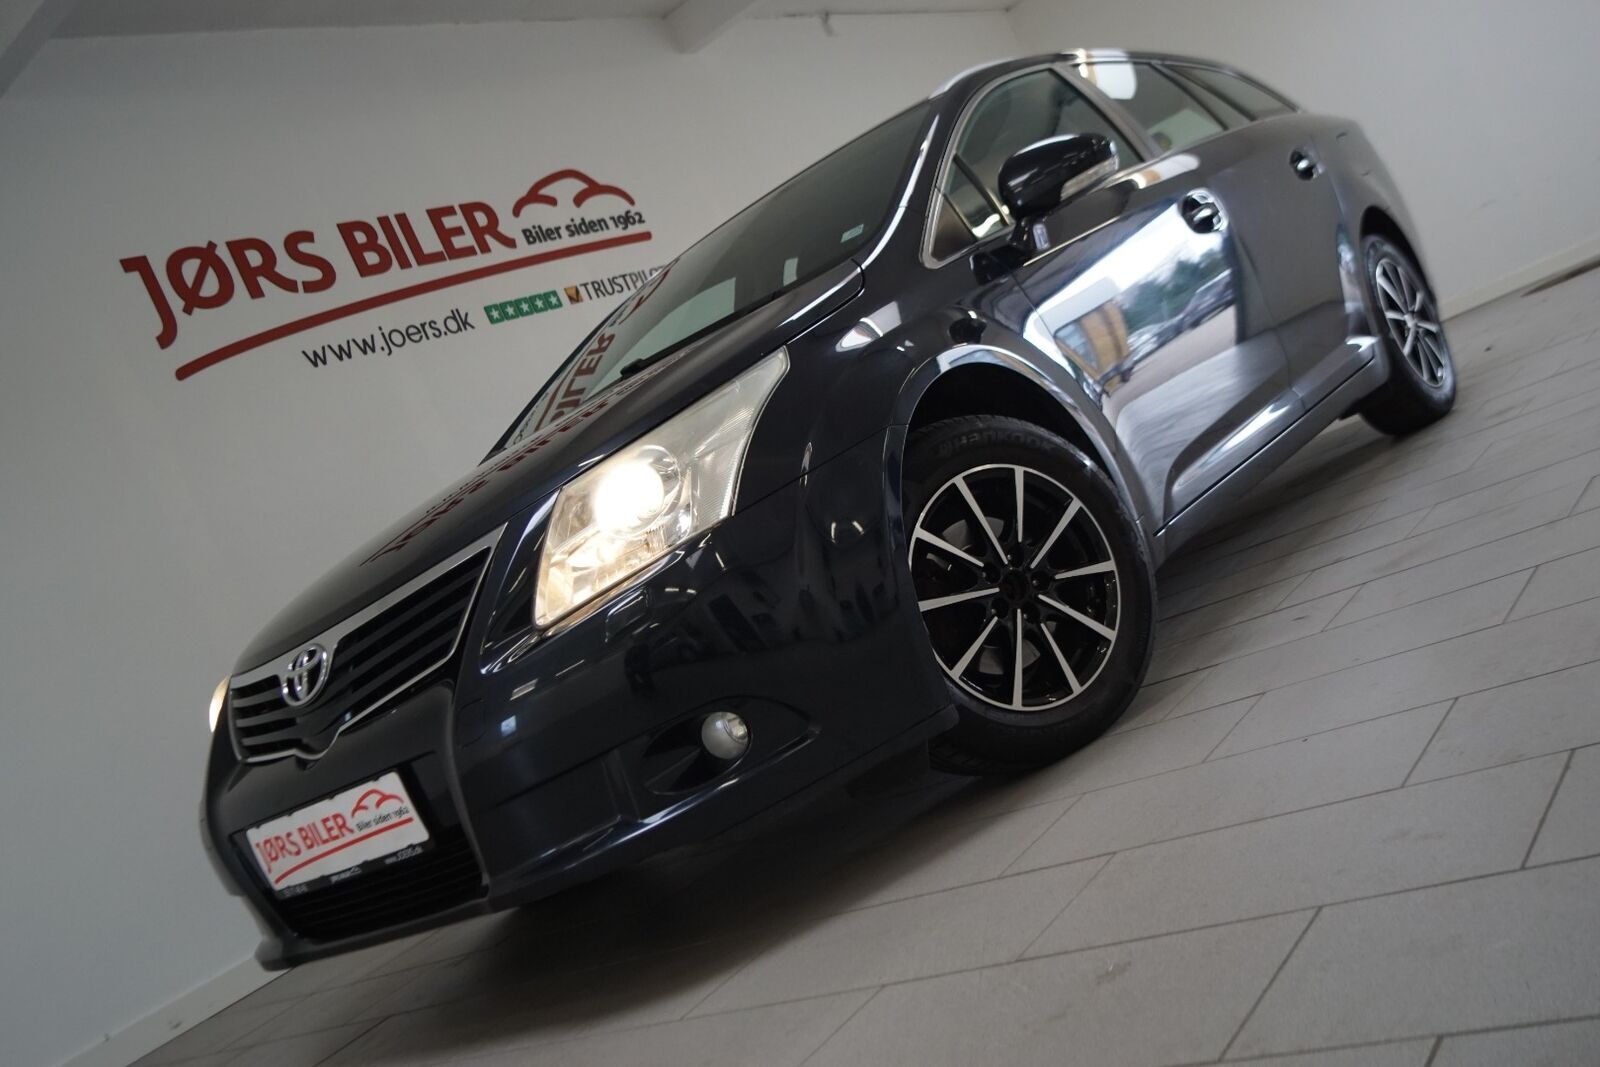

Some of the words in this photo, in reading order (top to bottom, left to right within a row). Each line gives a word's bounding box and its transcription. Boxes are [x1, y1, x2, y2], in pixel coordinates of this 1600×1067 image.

[521, 225, 563, 245] Biler
[565, 218, 610, 237] siden
[609, 210, 645, 231] 1962
[119, 230, 337, 350] JØRS
[336, 201, 517, 278] BILER
[302, 308, 476, 368] www.joers.dk
[256, 832, 302, 874] JØRS
[297, 813, 354, 850] BILER
